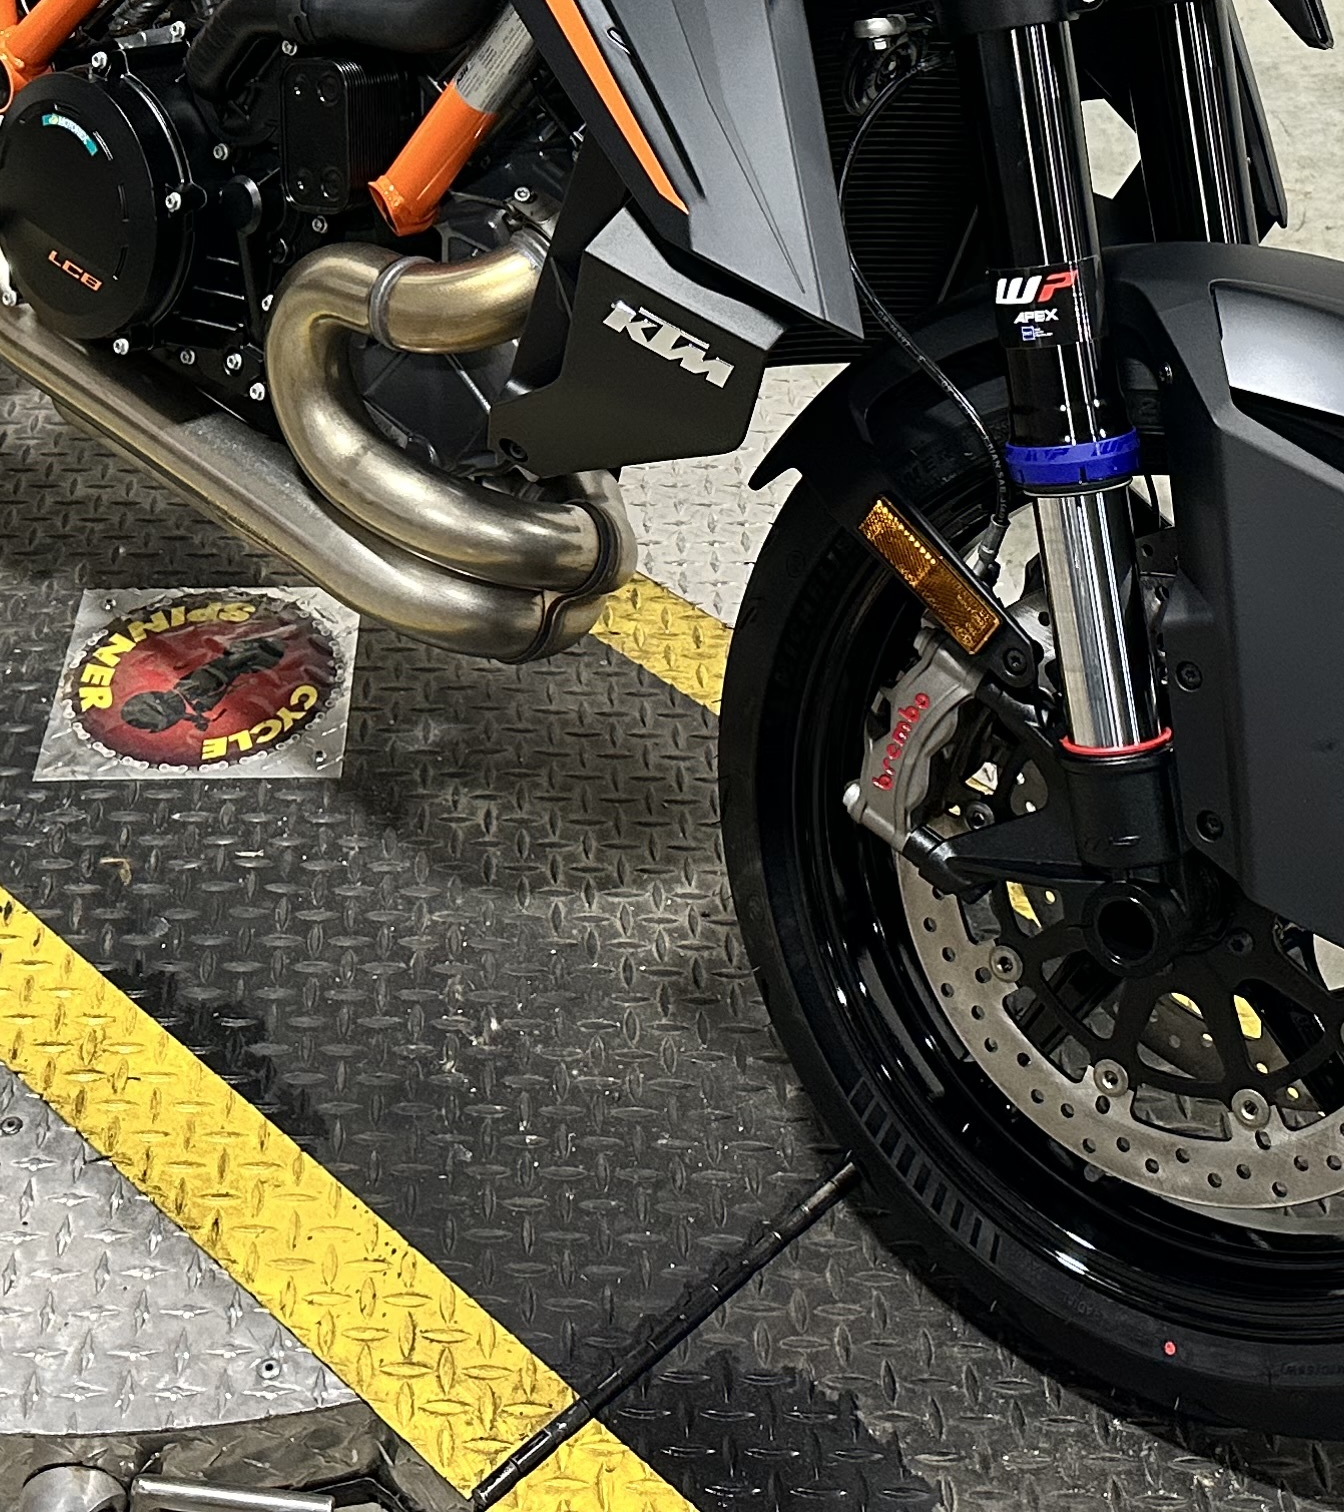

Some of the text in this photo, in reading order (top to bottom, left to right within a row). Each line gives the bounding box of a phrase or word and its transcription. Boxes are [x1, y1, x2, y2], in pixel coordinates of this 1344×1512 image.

[48, 250, 102, 292] LC8
[995, 269, 1078, 304] WP
[602, 299, 734, 388] KTM
[1013, 308, 1059, 324] APEX
[78, 602, 256, 712] SPINNER
[201, 685, 319, 760] CYCLE
[872, 692, 930, 791] brembo
